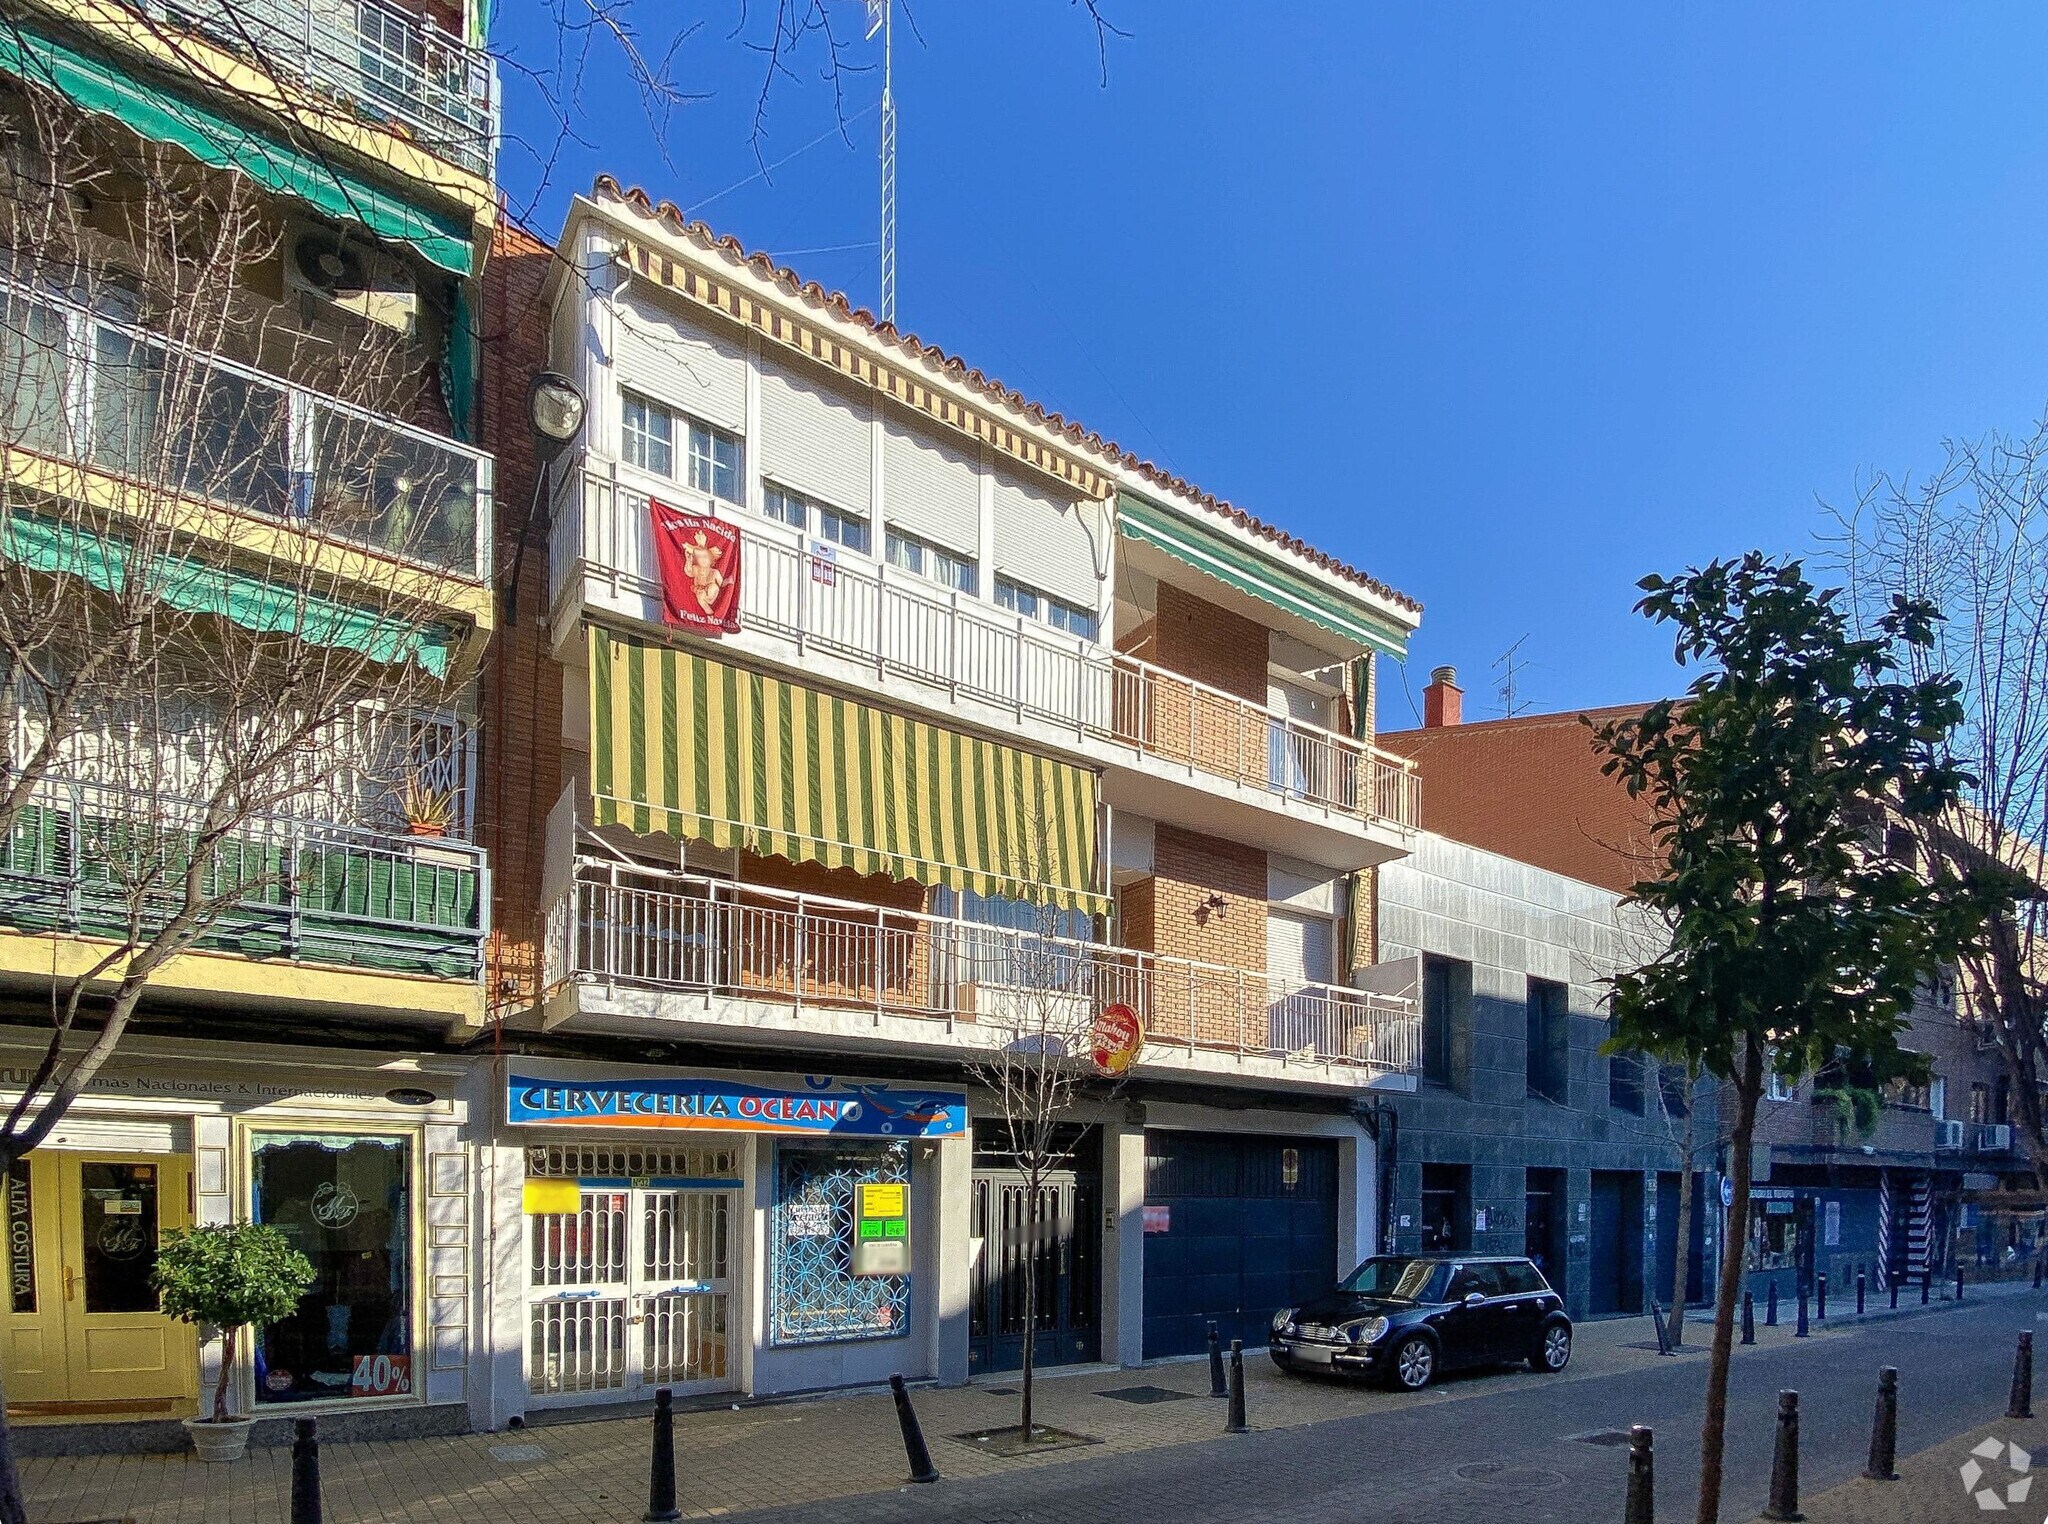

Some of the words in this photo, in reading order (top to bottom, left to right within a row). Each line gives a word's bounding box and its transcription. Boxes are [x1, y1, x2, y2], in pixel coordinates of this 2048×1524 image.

[702, 519, 737, 543] Nacido
[679, 609, 706, 624] Feliz
[1096, 1020, 1131, 1043] Mahou
[136, 1077, 233, 1095] Nacionales
[238, 1083, 251, 1095] &
[256, 1083, 376, 1102] Internacionales
[10, 1177, 28, 1217] ALTA
[11, 1219, 31, 1296] COSTURA
[352, 1354, 410, 1392] 40%
